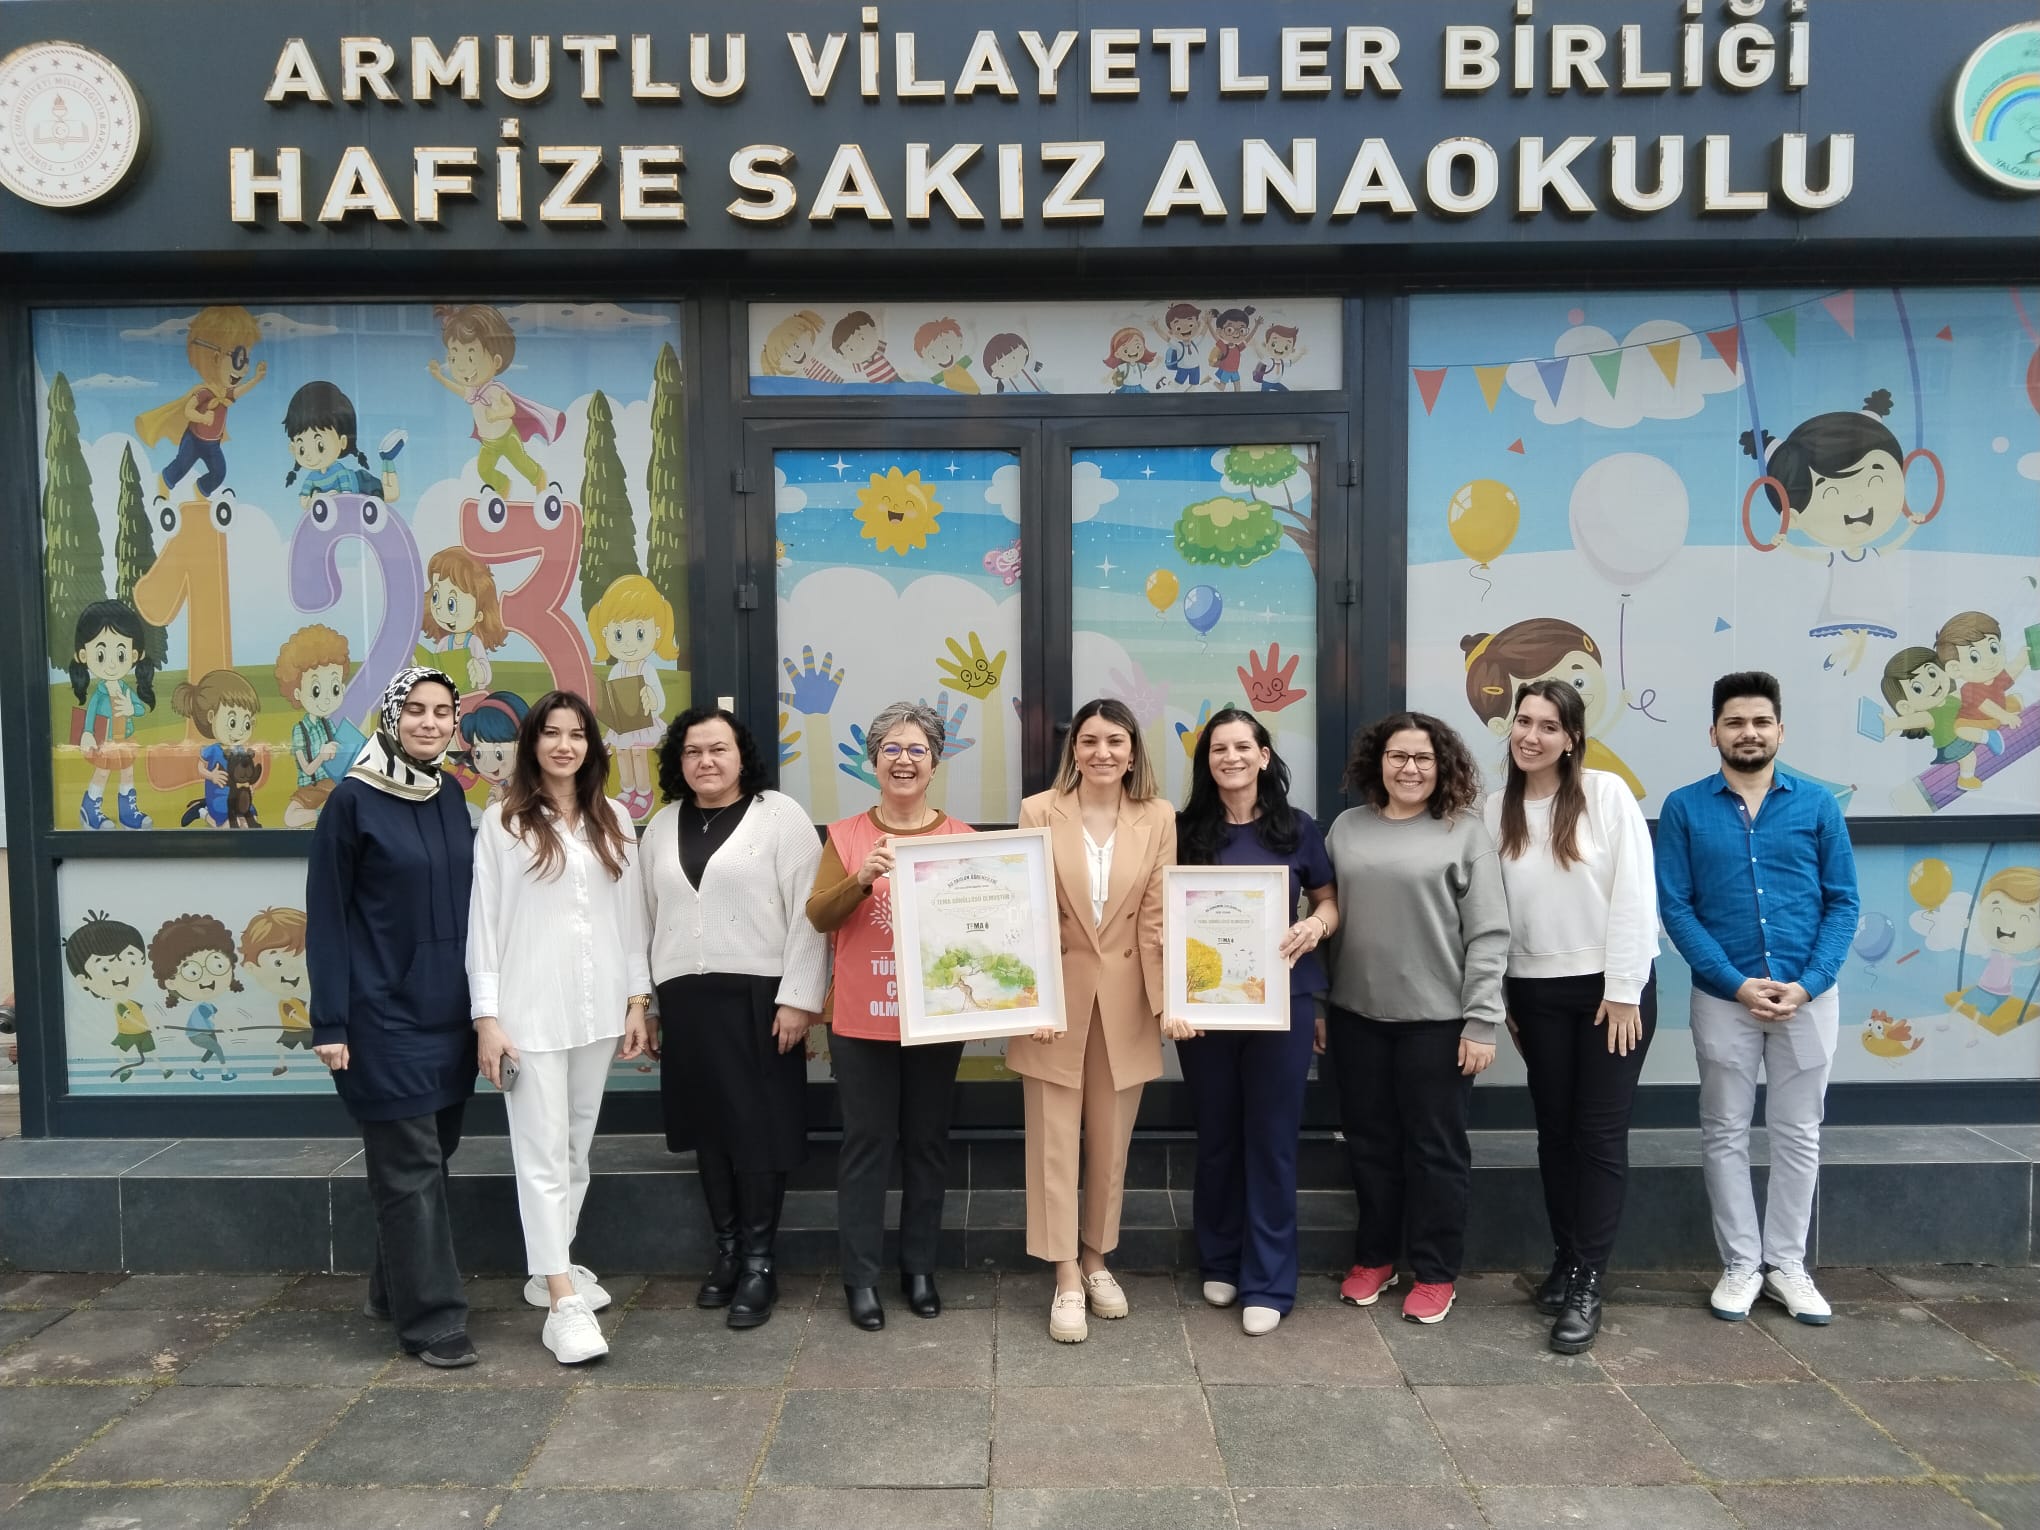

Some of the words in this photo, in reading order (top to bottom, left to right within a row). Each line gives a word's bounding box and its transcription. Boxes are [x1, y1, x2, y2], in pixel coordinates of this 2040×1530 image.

[264, 34, 746, 103] ARMUTLU
[787, 6, 1402, 98] VİLAYETLER
[1444, 0, 1809, 92] BİRLİĞİ
[229, 117, 685, 223] HAFİZE
[725, 140, 1105, 222] SAKIZ
[1143, 132, 1855, 218] ANAOKULU
[870, 956, 897, 976] TÜR
[886, 980, 897, 999] Ç
[869, 1000, 899, 1017] OLM
